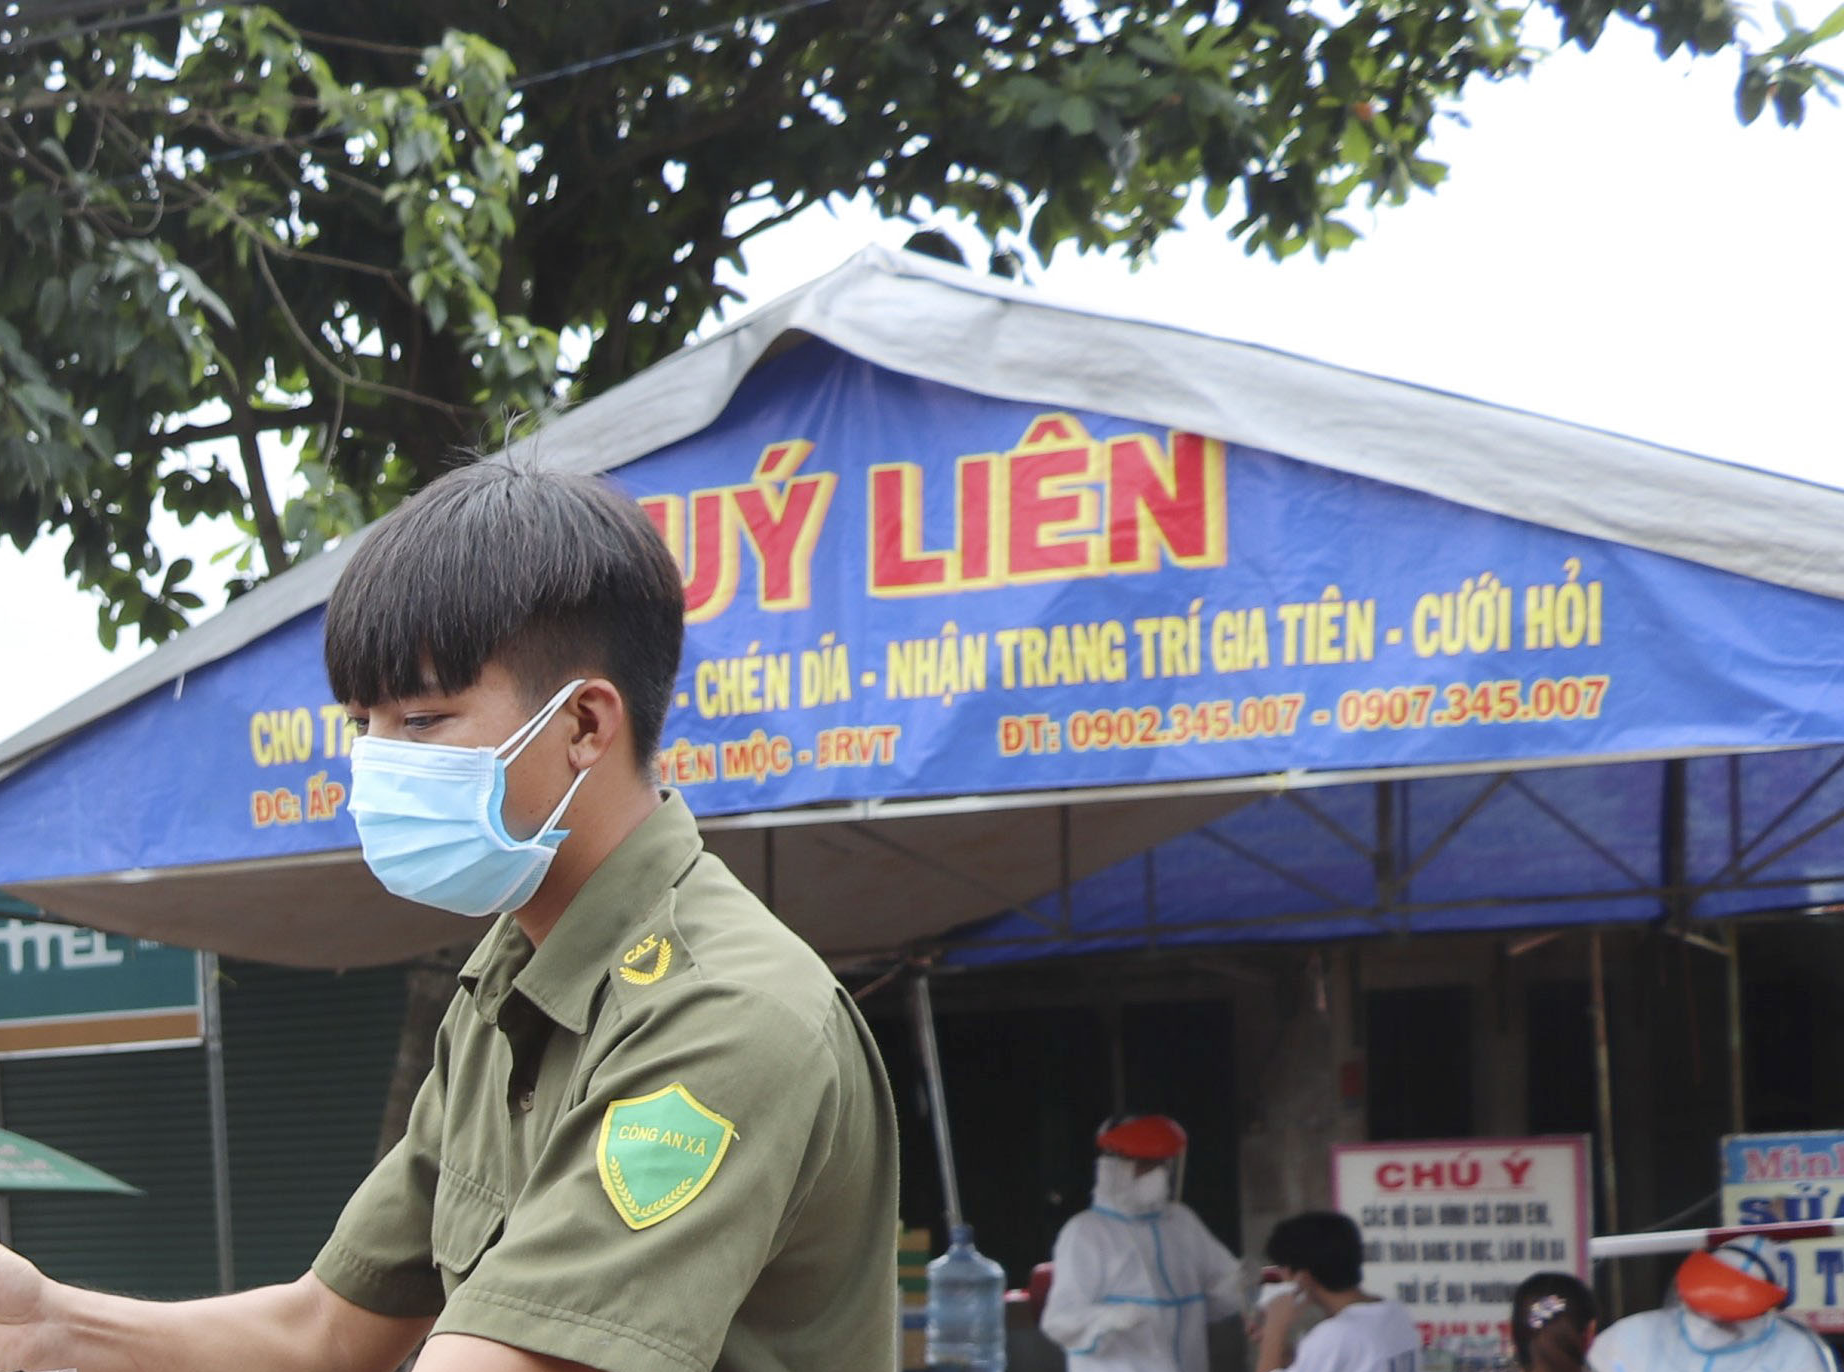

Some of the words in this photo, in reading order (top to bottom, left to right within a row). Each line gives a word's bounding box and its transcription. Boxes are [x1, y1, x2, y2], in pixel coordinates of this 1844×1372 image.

[638, 438, 840, 626] UÝ
[866, 412, 1228, 598] LIÊN
[250, 706, 314, 768] CHO
[319, 703, 356, 759] TH
[694, 640, 791, 720] CHÉN
[886, 621, 988, 707] NHẬN
[995, 620, 1127, 690] TRANG
[1134, 597, 1204, 679] TRÍ
[1210, 606, 1270, 673] GIA
[1277, 584, 1376, 667] TIÊN
[1412, 572, 1513, 658] CƯỚI
[1524, 556, 1603, 651] HỎI
[306, 770, 346, 823] ẤP
[658, 738, 717, 785] YÊN
[723, 729, 794, 785] MỘC
[815, 724, 903, 769] BRVT
[998, 712, 1062, 756] ĐT:
[1068, 693, 1306, 751] 0902.345.007
[1336, 675, 1610, 732] 0907.345.007
[618, 1121, 660, 1142] CÔNG
[660, 1130, 684, 1150] AN
[685, 1137, 709, 1157] XÃ
[1375, 1150, 1482, 1190] CHÚ
[1499, 1149, 1535, 1187] Ý
